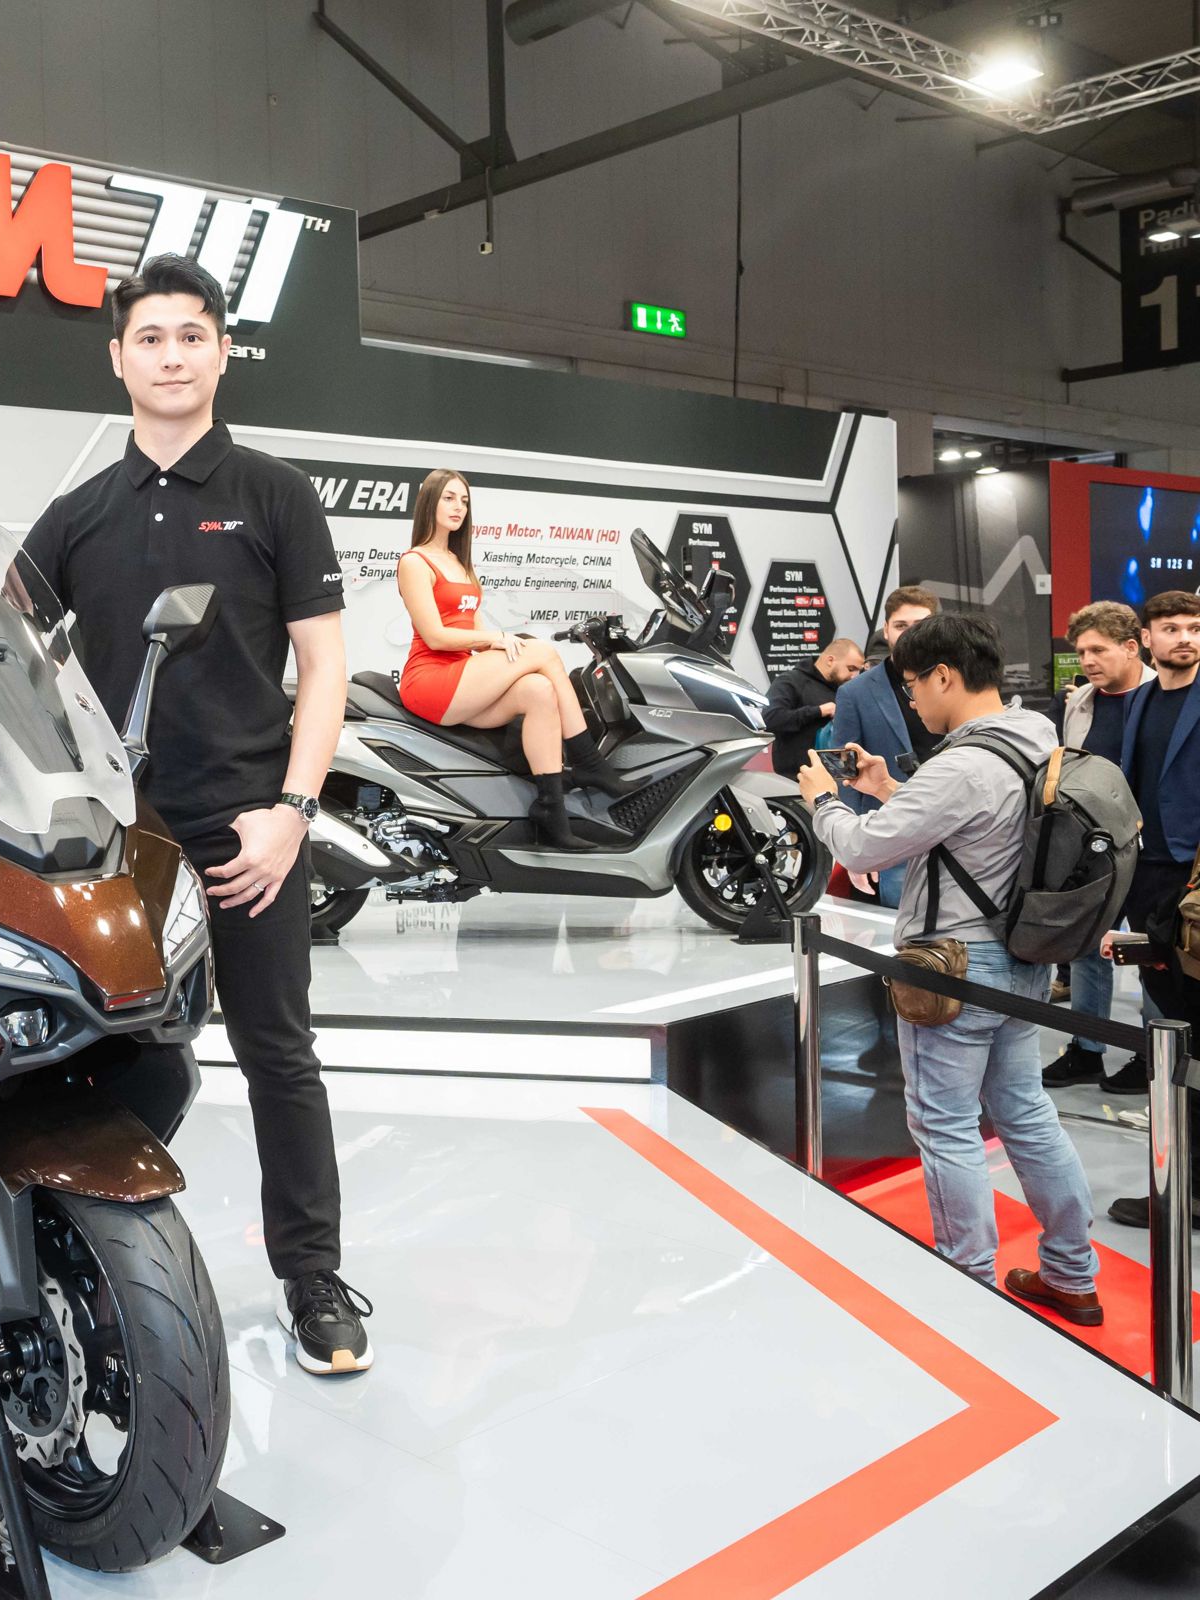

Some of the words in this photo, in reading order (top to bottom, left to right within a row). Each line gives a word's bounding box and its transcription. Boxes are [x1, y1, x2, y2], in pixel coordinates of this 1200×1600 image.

[1140, 275, 1200, 351] 1
[349, 480, 410, 512] ERA
[506, 524, 543, 540] Motor,
[550, 526, 593, 541] TAIWAN
[597, 529, 620, 544] (HQ)
[692, 522, 712, 535] SYM
[482, 552, 523, 566] Xiashing
[583, 556, 612, 566] CHINA
[1167, 558, 1182, 569] 125
[785, 570, 803, 582] SYM
[583, 578, 612, 589] CHINA
